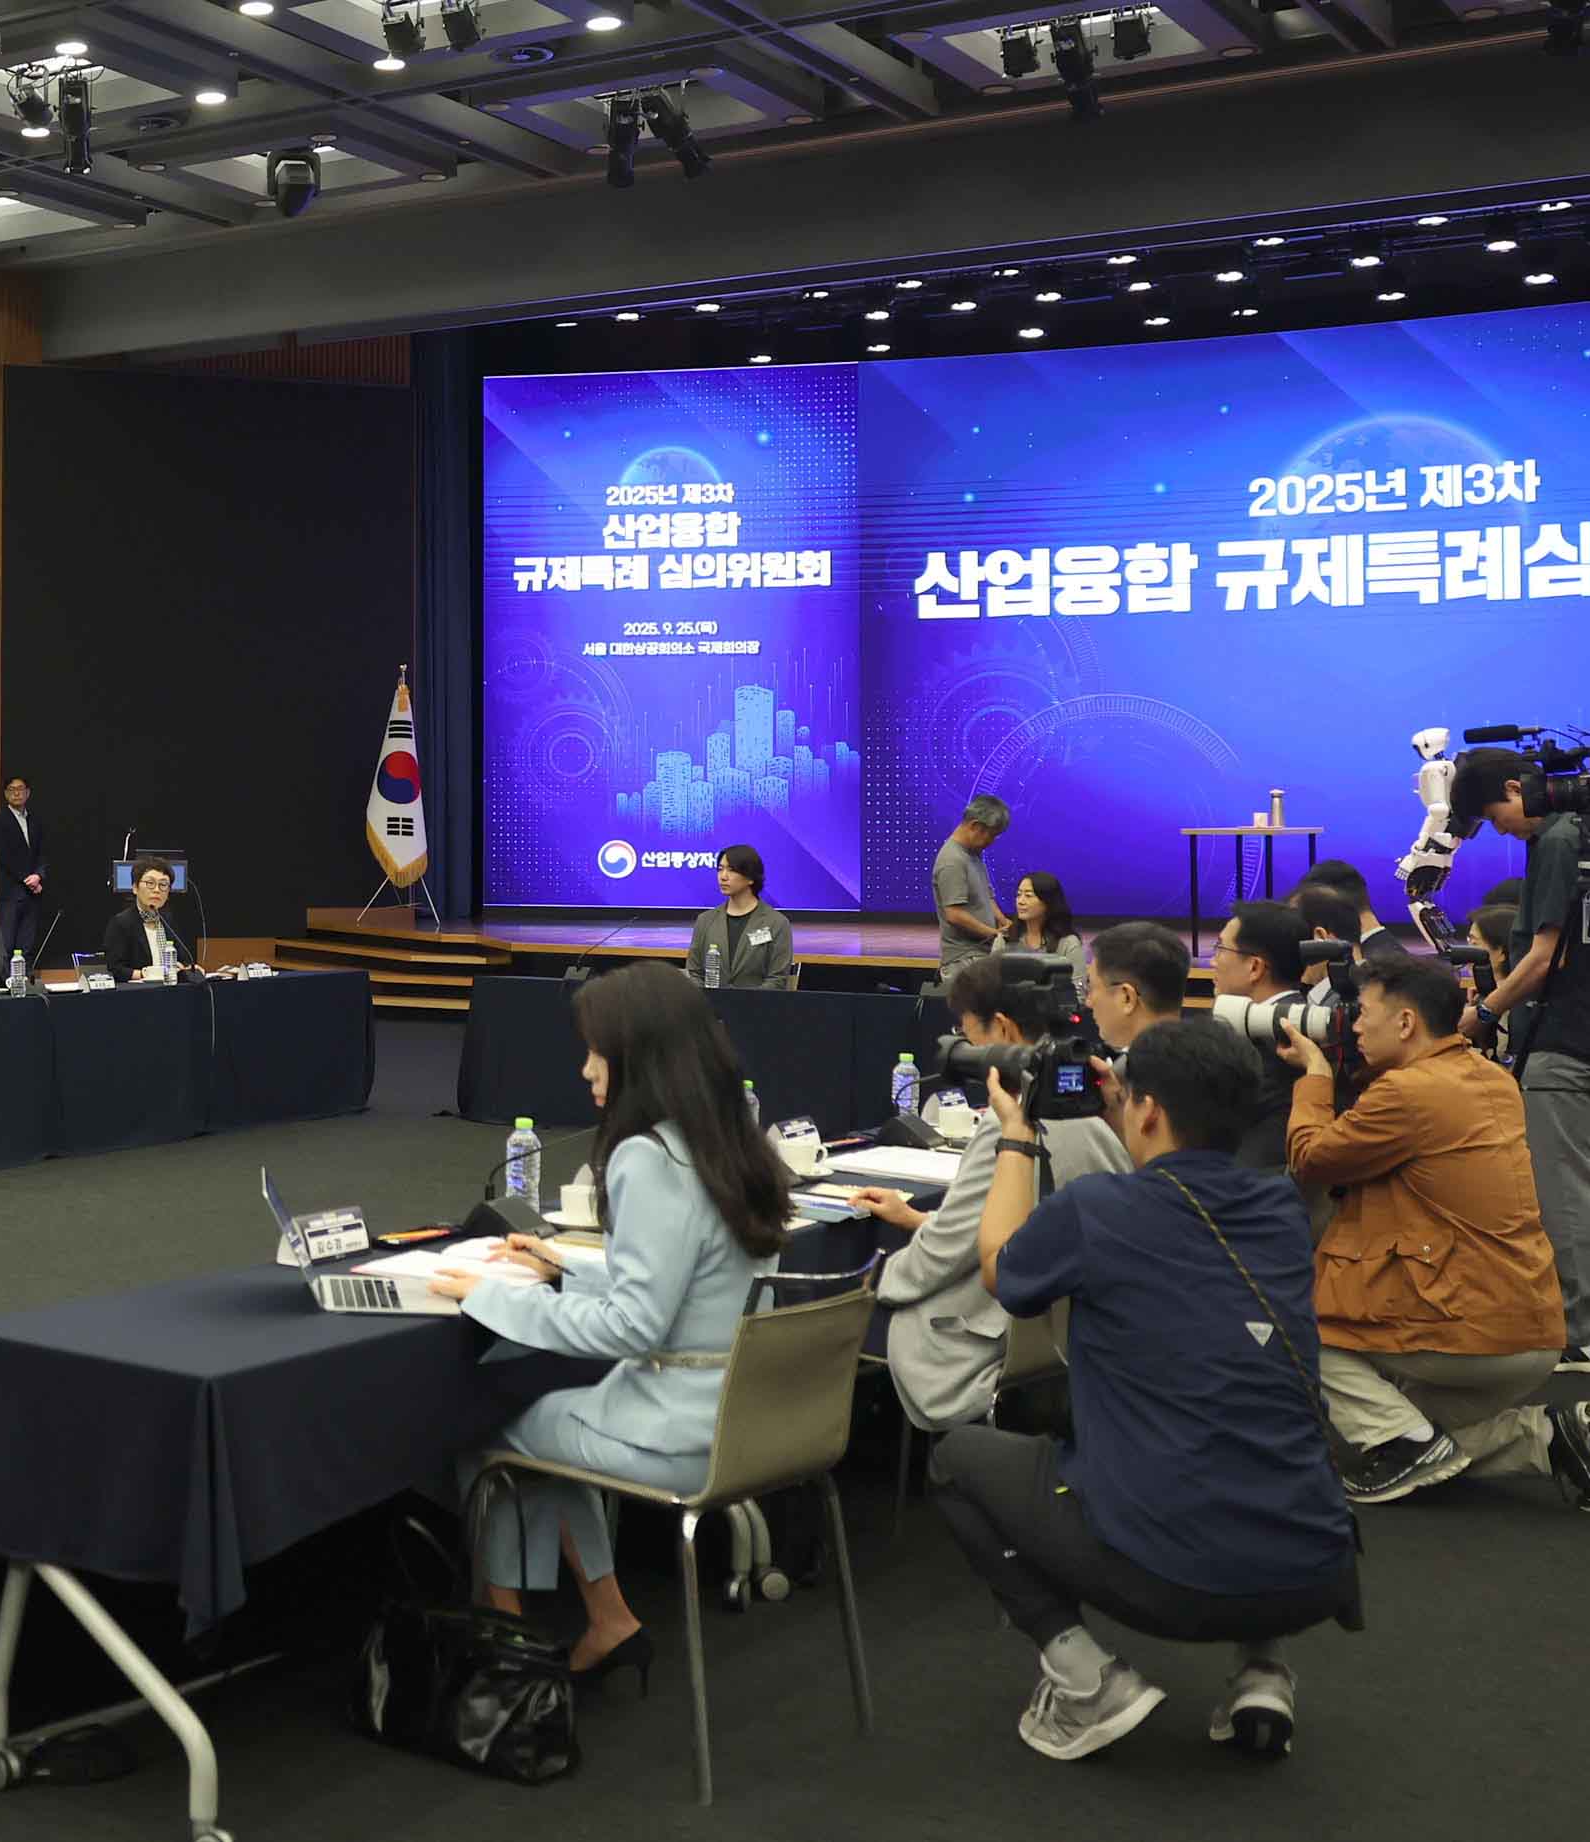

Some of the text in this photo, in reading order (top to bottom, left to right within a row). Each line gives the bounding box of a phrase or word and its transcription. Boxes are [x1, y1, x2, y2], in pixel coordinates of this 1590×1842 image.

[606, 482, 735, 506] 2025년 제3차
[1250, 459, 1541, 517] 2025년 제3차
[601, 511, 742, 550] 산업융합
[513, 550, 831, 593] 규제특례 심의위원회
[913, 542, 1200, 620] 산업융합
[623, 620, 661, 636] 2025.
[663, 620, 674, 635] 9.
[582, 640, 760, 656] 서울 대한상공회의소 국제회의장
[641, 851, 718, 869] 산업통상자
